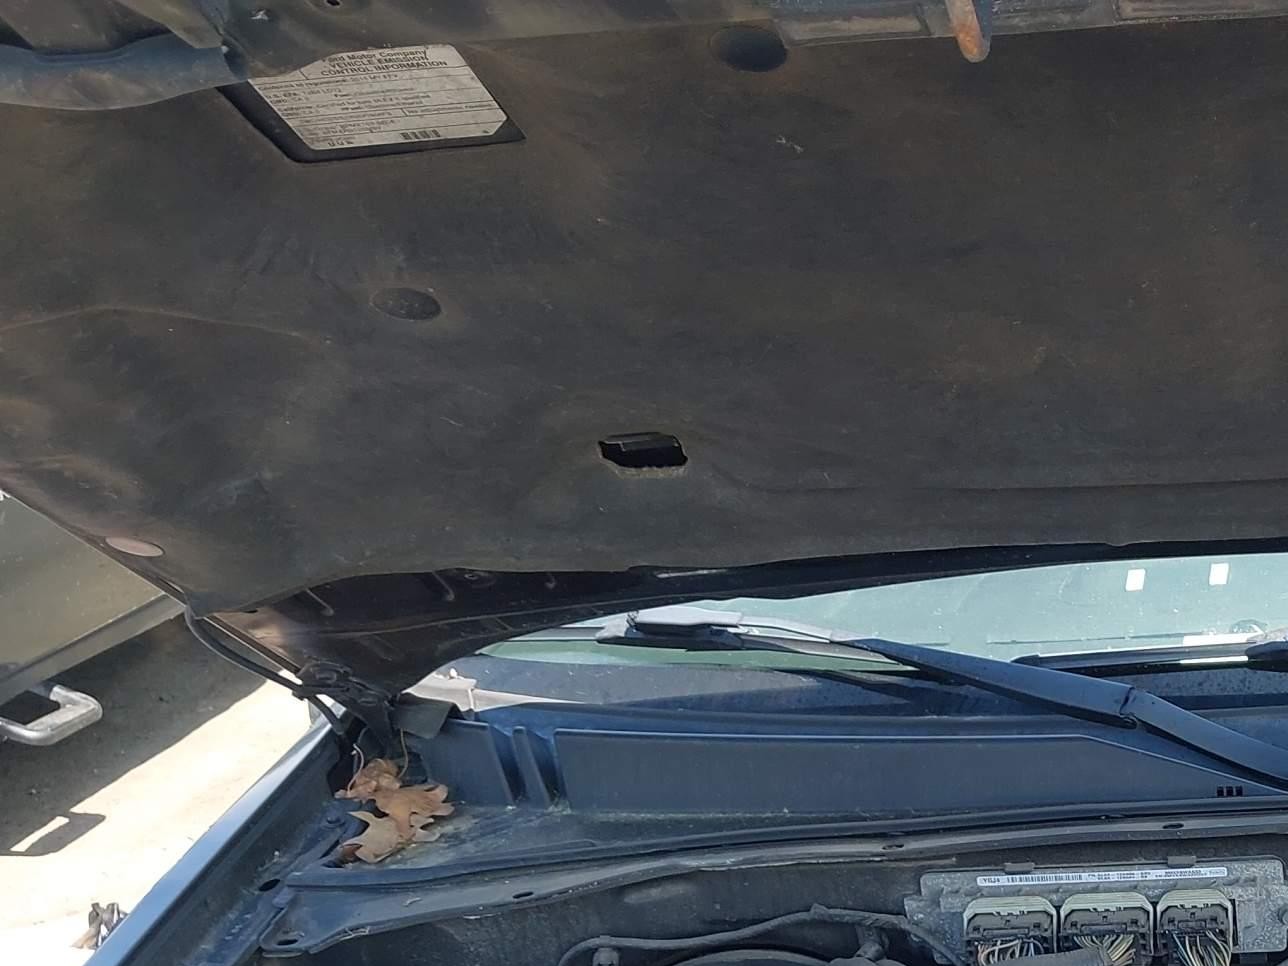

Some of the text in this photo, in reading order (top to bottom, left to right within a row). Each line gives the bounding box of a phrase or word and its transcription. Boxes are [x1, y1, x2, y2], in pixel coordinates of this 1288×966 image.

[329, 54, 429, 69] VEHICLE EMISSION
[347, 52, 376, 62] Motor
[379, 49, 428, 60] Company
[320, 60, 448, 77] CONTROL INFORMATION
